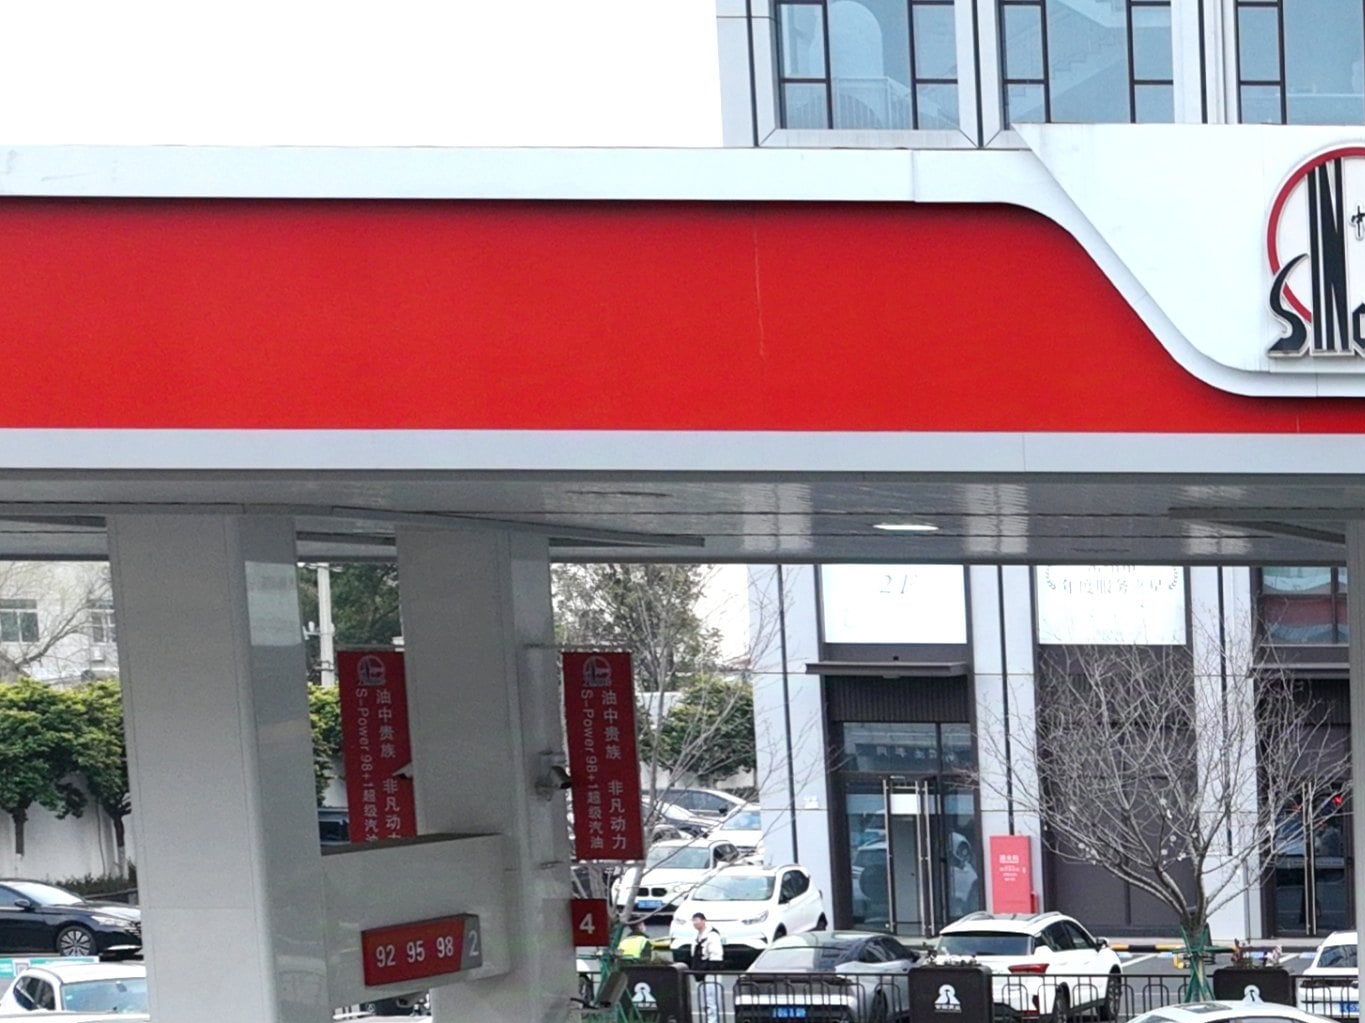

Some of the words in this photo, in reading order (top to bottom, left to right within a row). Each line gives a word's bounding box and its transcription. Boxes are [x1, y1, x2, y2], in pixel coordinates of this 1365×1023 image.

[376, 689, 396, 758] 油中贵族
[601, 691, 621, 759] 油中贵族
[608, 780, 626, 850] 非凡动力
[376, 945, 396, 967] 92
[407, 940, 425, 963] 95
[436, 936, 454, 958] 98
[468, 930, 479, 956] 2
[580, 913, 595, 934] 4
